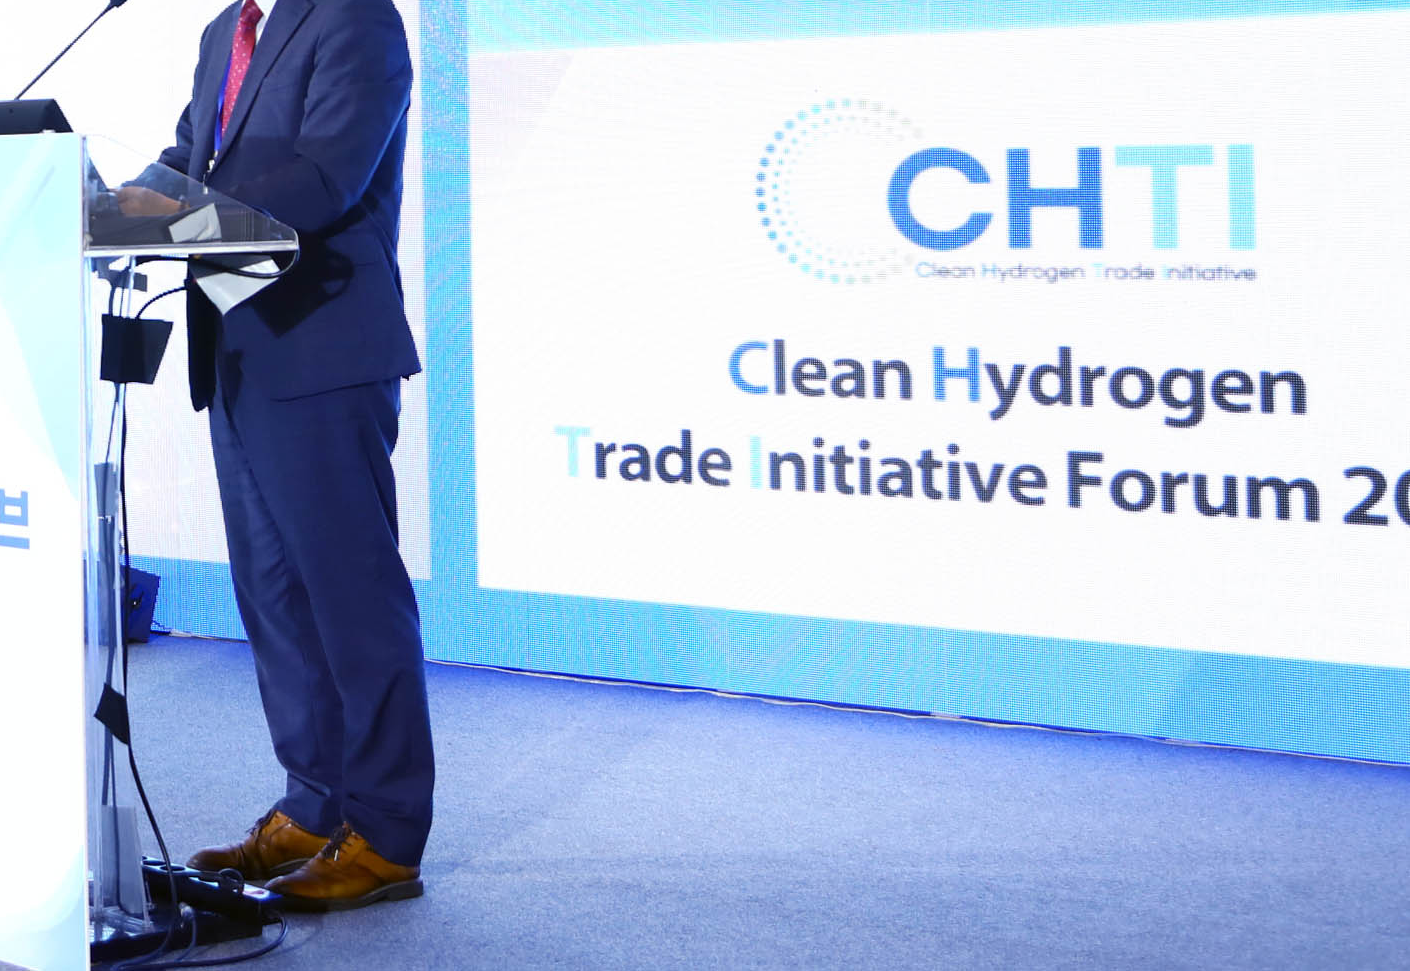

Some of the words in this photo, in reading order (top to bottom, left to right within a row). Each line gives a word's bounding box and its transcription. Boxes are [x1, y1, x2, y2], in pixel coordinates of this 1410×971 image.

[886, 144, 1258, 252] CHTI
[915, 261, 976, 279] Clean
[981, 262, 1086, 283] Hydrogen
[1092, 262, 1156, 280] Trade
[1162, 263, 1257, 281] Initiative
[728, 338, 913, 401] Clean
[931, 345, 1308, 429] Hydrogen
[555, 427, 733, 487] Trade
[748, 435, 1048, 506] Initiative
[1065, 450, 1320, 523] Forum
